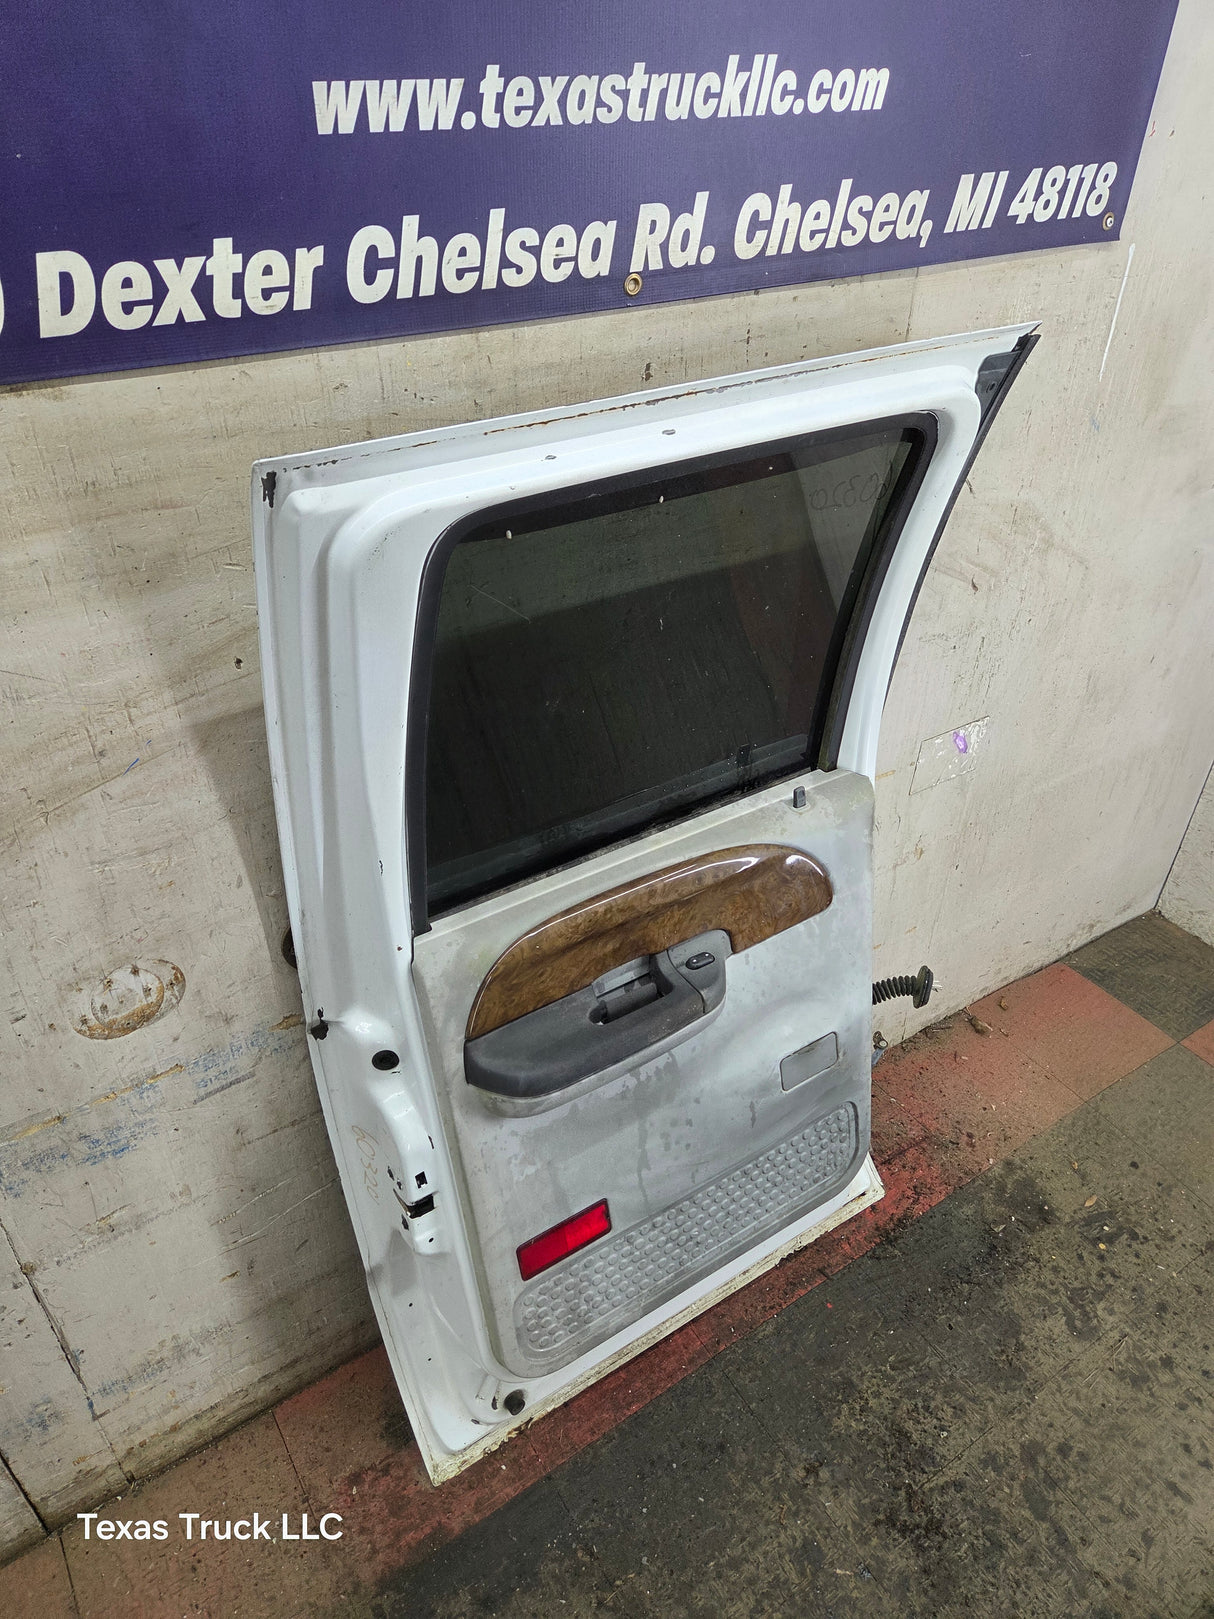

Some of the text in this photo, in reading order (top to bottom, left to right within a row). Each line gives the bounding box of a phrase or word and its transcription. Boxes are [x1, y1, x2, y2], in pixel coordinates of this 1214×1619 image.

[311, 53, 891, 135] www.texastruckllc.com
[35, 237, 325, 339] Dexter
[346, 207, 618, 304] Chelsea
[629, 190, 716, 273] Rd.
[733, 177, 934, 260] Chelsea,
[943, 170, 1010, 234] MI
[1006, 161, 1118, 225] 48118
